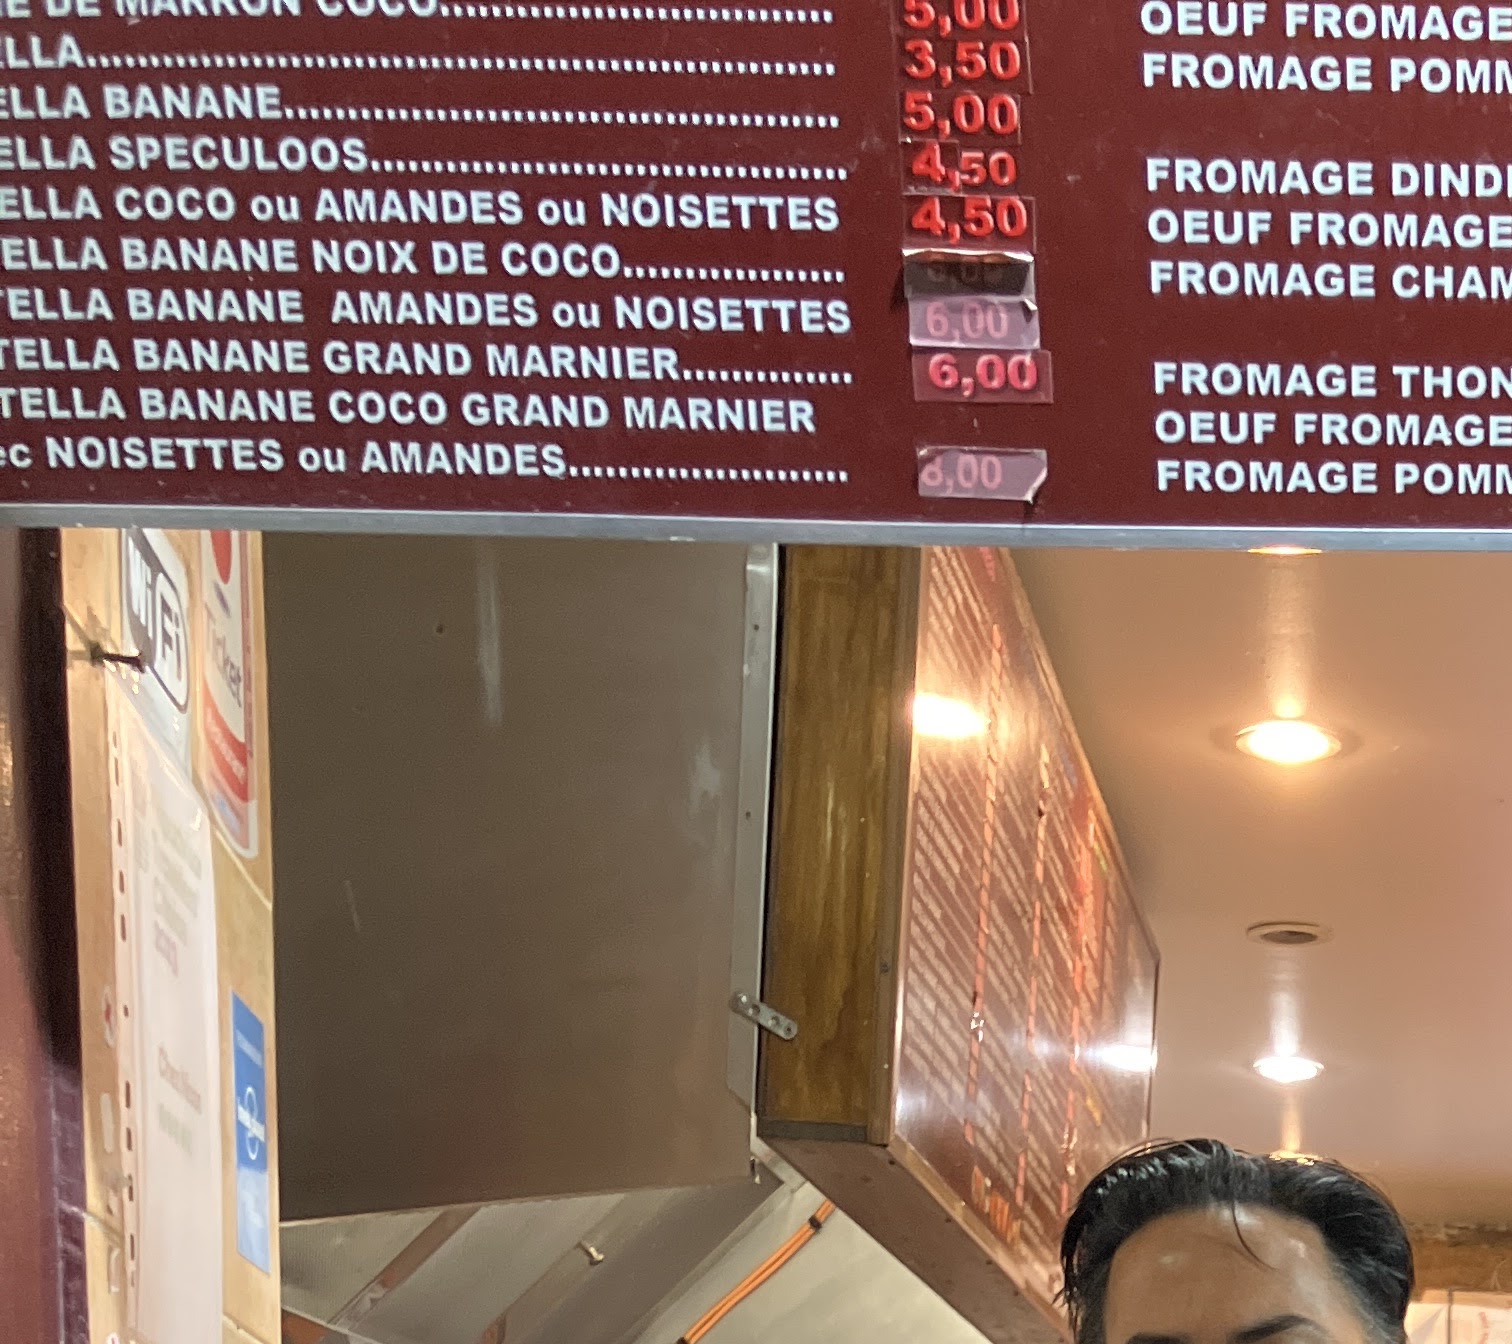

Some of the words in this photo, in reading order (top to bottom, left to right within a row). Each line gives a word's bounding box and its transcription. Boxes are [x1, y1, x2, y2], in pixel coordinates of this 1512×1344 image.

[903, 0, 1020, 36] 5,00
[1140, 0, 1268, 37] OEUF
[0, 33, 85, 69] LLA
[904, 39, 1021, 87] 3,50
[1143, 51, 1373, 92] FROMAGE
[102, 84, 283, 120] BANANE
[903, 91, 1019, 139] 5,00
[108, 135, 368, 172] SPECULOOS
[912, 142, 1017, 194] 4,50
[1146, 157, 1375, 196] FROMAGE
[115, 186, 236, 221] COCO
[250, 195, 300, 222] ou
[314, 187, 523, 225] AMANDES
[537, 198, 586, 226] ou
[600, 192, 840, 232] NOISETTES
[912, 196, 1028, 244] 4,50
[1147, 207, 1272, 245] OEUF
[120, 237, 299, 272] BANANE
[311, 239, 418, 274] NOIX
[431, 240, 488, 275] DE
[501, 241, 620, 278] COCO
[1150, 260, 1376, 298] FROMAGE
[126, 288, 305, 323] BANANE
[331, 290, 538, 327] AMANDES
[552, 301, 601, 329] ou
[614, 295, 851, 334] NOISETTES
[926, 301, 1008, 342] 6,00
[133, 338, 310, 373] BANANE
[323, 340, 472, 376] GRAND
[485, 343, 680, 381] MARNIER
[928, 352, 1038, 397] 6,00
[1153, 361, 1377, 398] FROMAGE
[139, 387, 316, 422] BANANE
[328, 390, 447, 425] COCO
[461, 392, 609, 428] GRAND
[623, 395, 816, 433] MARNIER
[1155, 410, 1277, 445] OEUF
[45, 436, 284, 471] NOISETTES
[298, 447, 346, 473] ou
[360, 440, 566, 479] AMANDES
[1157, 459, 1378, 494] FROMAGE
